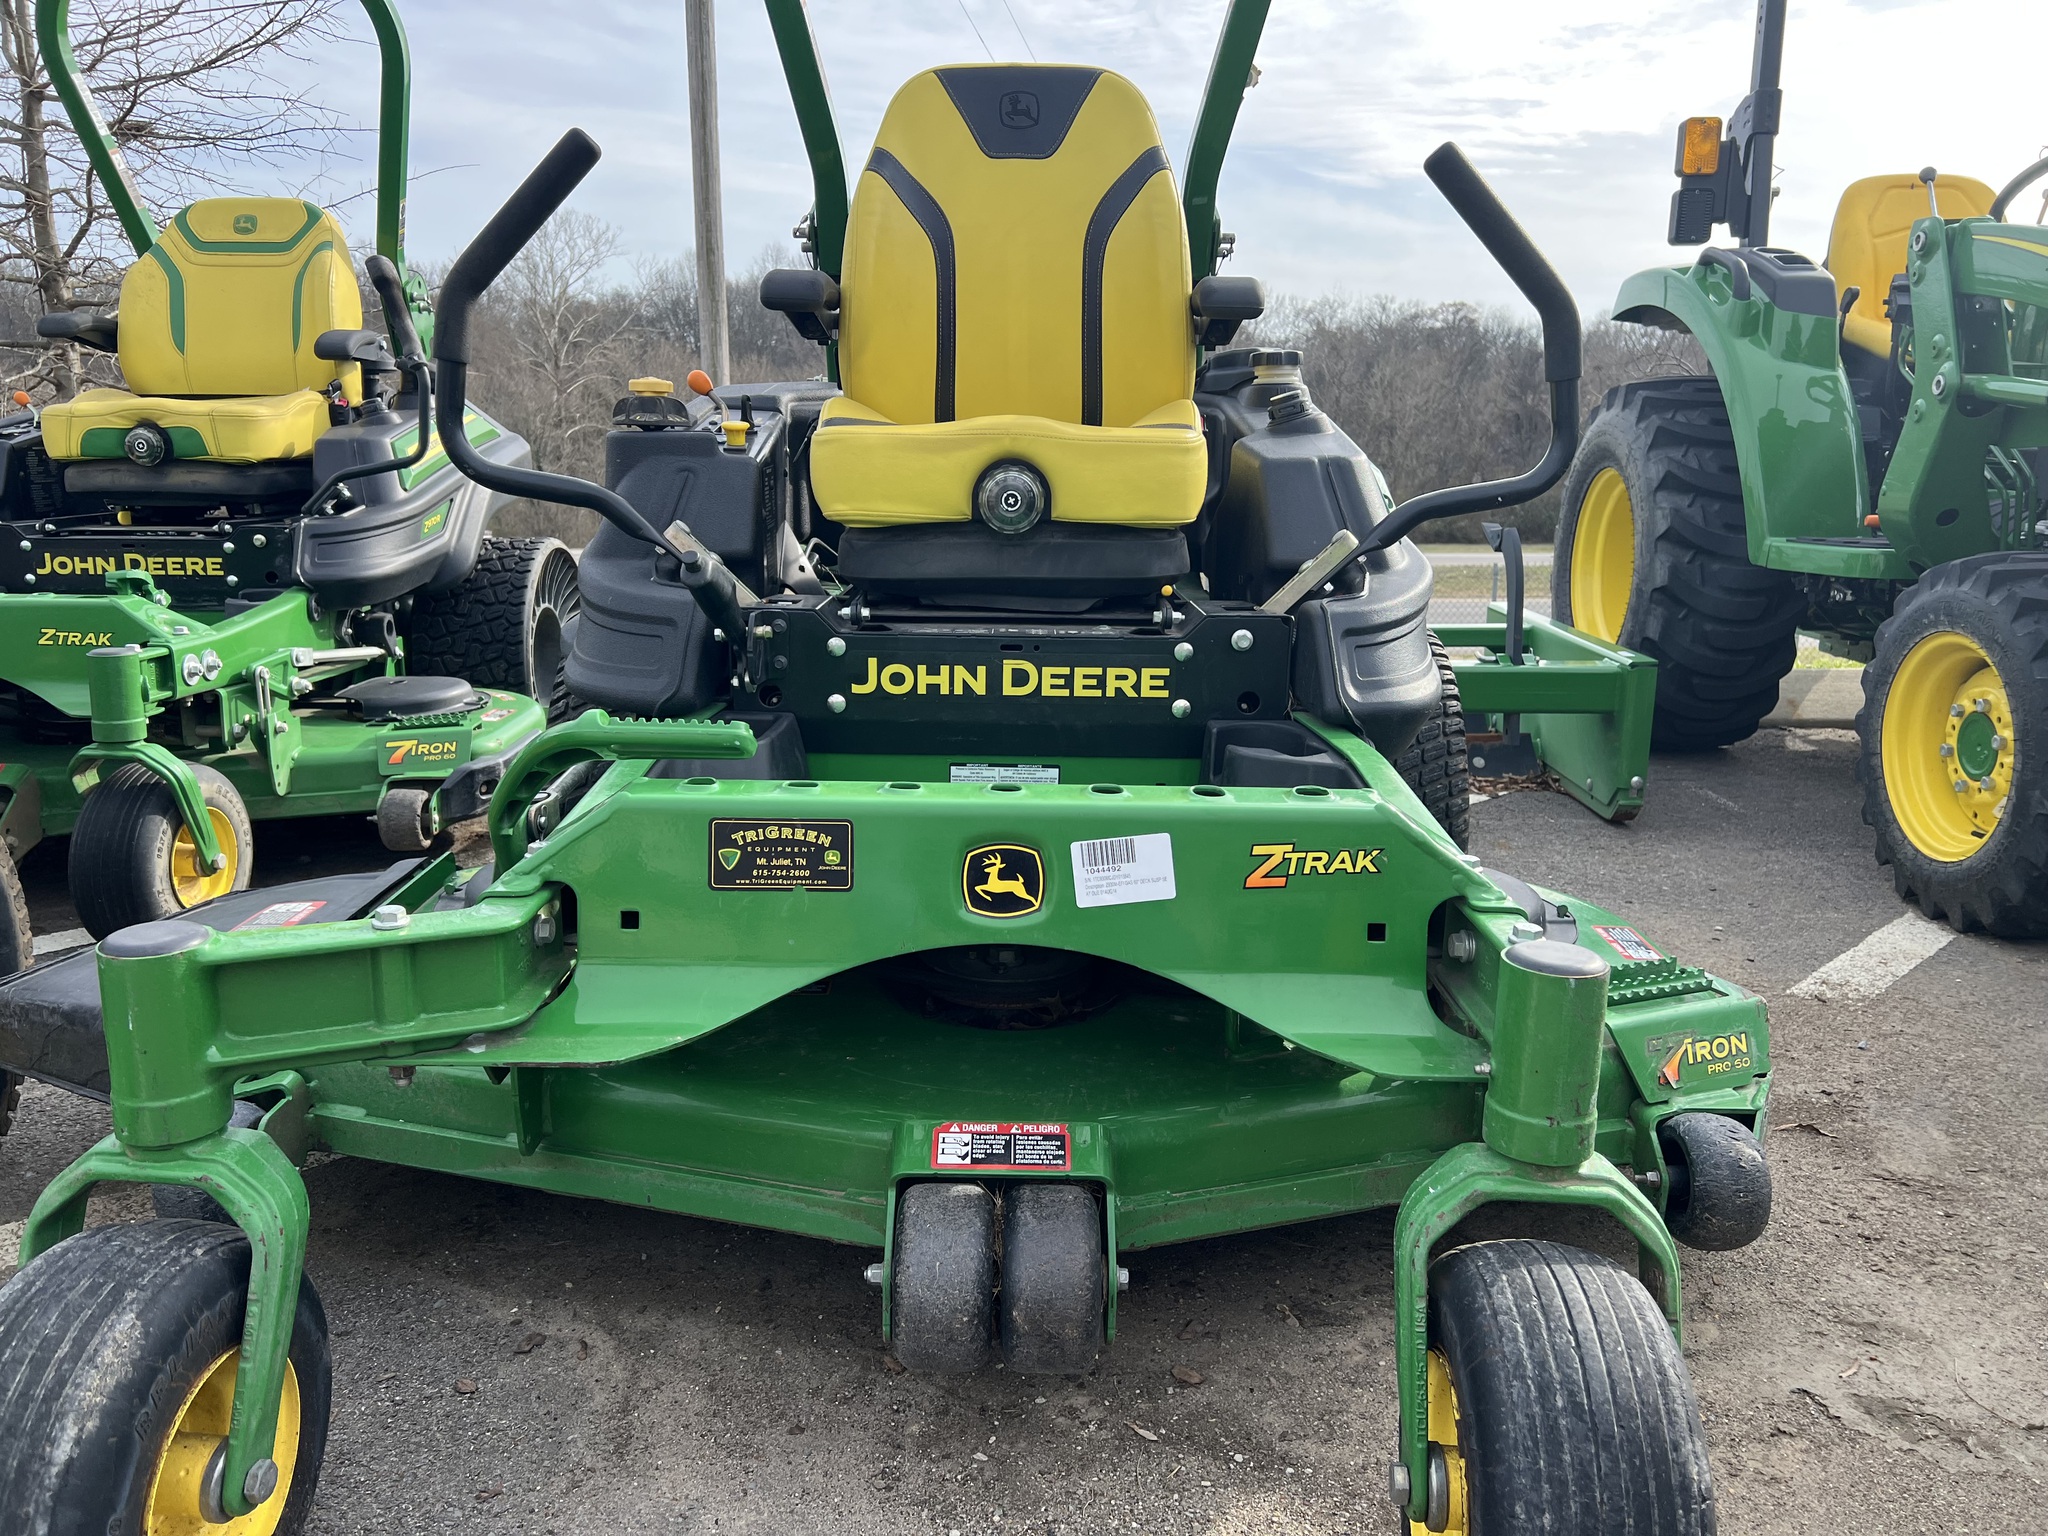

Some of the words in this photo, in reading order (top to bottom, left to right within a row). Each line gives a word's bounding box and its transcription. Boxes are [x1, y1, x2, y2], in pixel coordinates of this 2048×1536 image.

[36, 553, 116, 575] JOHN
[124, 553, 224, 576] DEERE
[38, 628, 114, 646] ZTRAK
[851, 658, 986, 695] JOHN
[1002, 659, 1170, 698] DEERE
[770, 858, 793, 866] Juliet,
[1243, 843, 1385, 889] ZTRAK
[1085, 865, 1122, 875] 1044492
[1707, 1061, 1731, 1074] PRO
[962, 1124, 998, 1132] DANGER
[1024, 1125, 1060, 1133] PELIGRO
